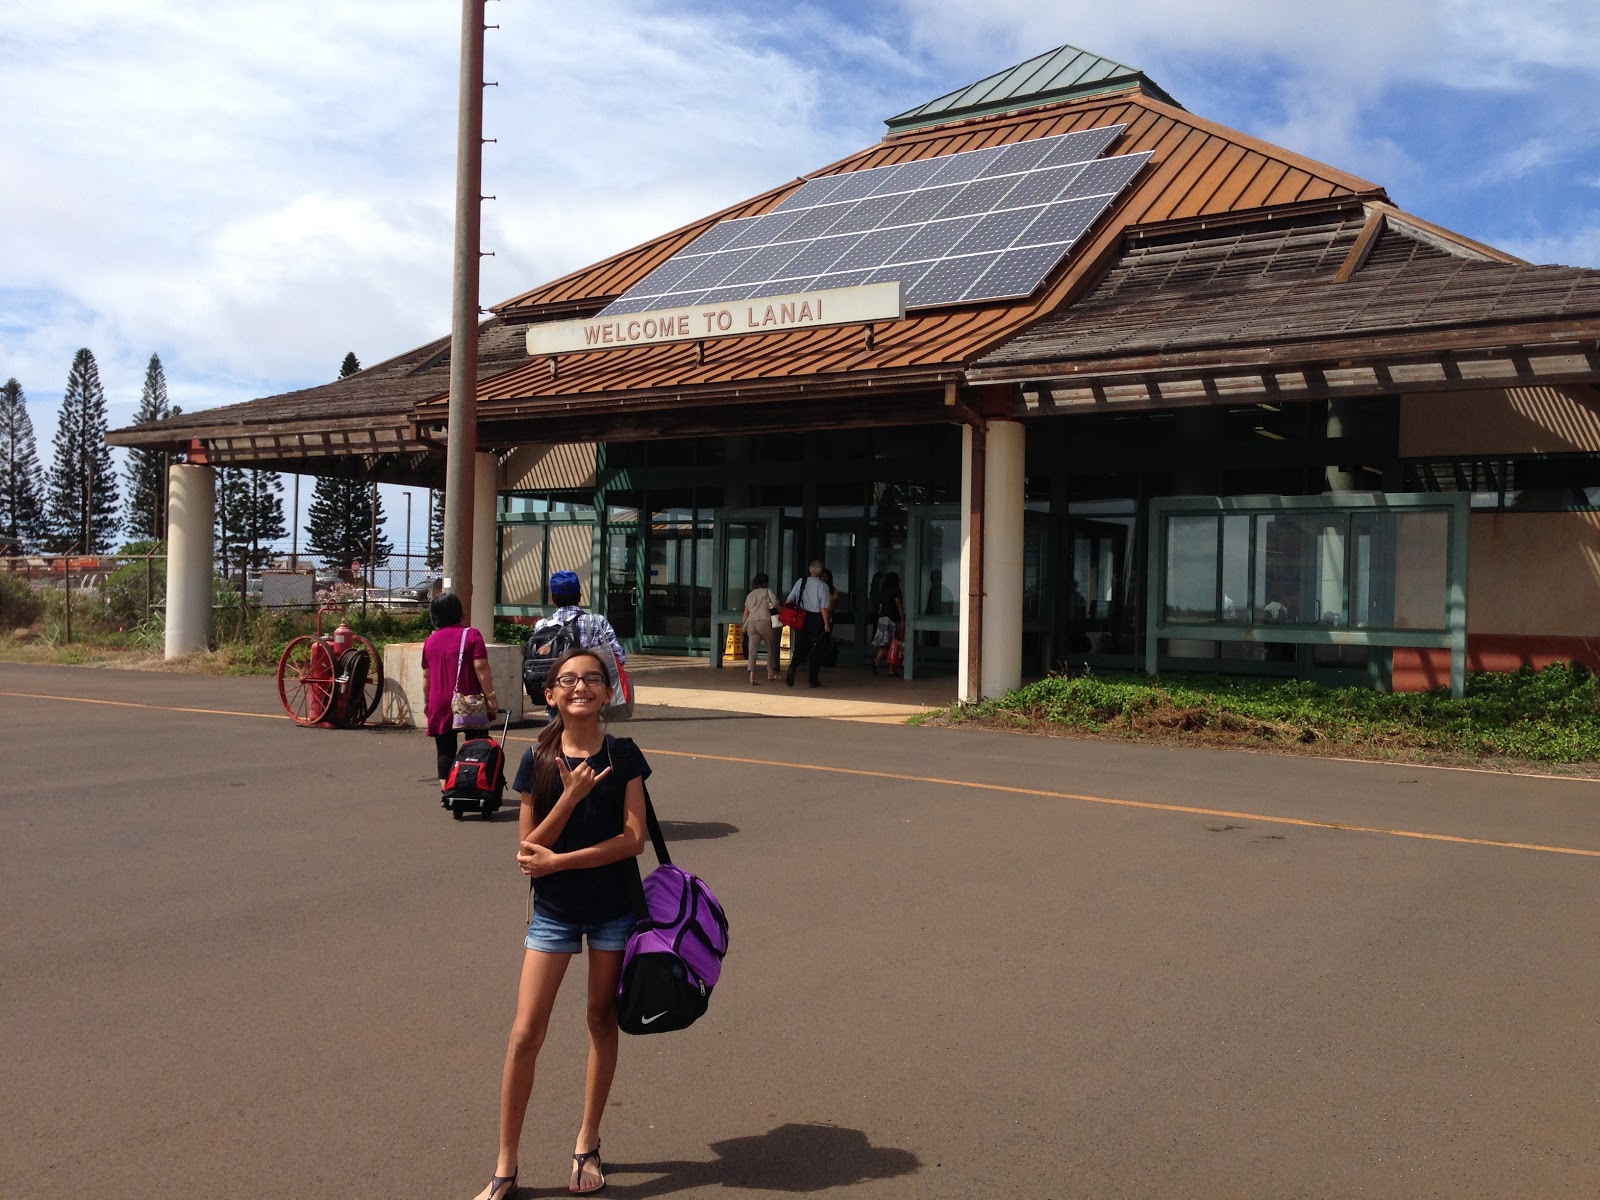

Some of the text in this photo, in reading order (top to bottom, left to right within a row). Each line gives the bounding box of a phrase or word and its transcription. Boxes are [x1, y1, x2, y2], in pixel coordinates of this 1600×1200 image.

[584, 299, 822, 345] WELCOME TO LANAI
